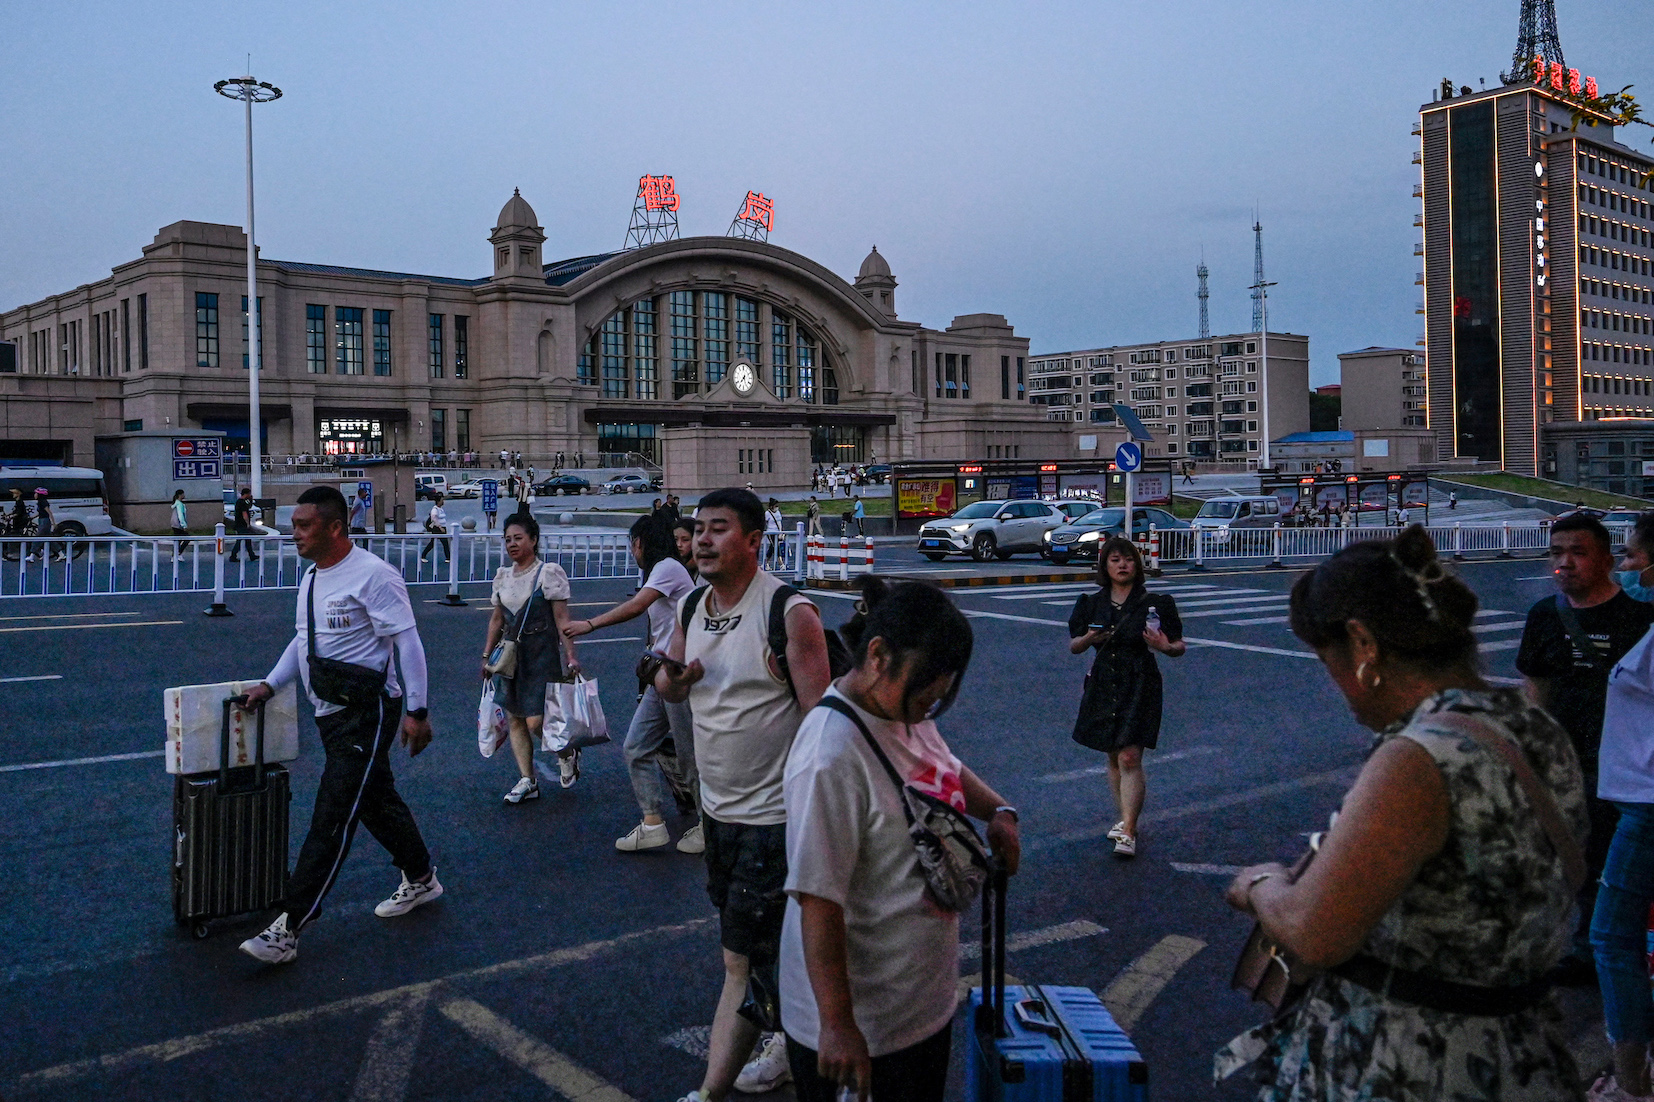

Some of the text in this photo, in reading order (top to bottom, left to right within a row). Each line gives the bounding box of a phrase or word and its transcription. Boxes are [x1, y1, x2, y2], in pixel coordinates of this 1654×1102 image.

[639, 174, 774, 232] 鹤岗
[197, 448, 217, 456] 驶入
[178, 461, 216, 477] 出口
[327, 615, 350, 629] WIN
[704, 614, 742, 631] 1977
